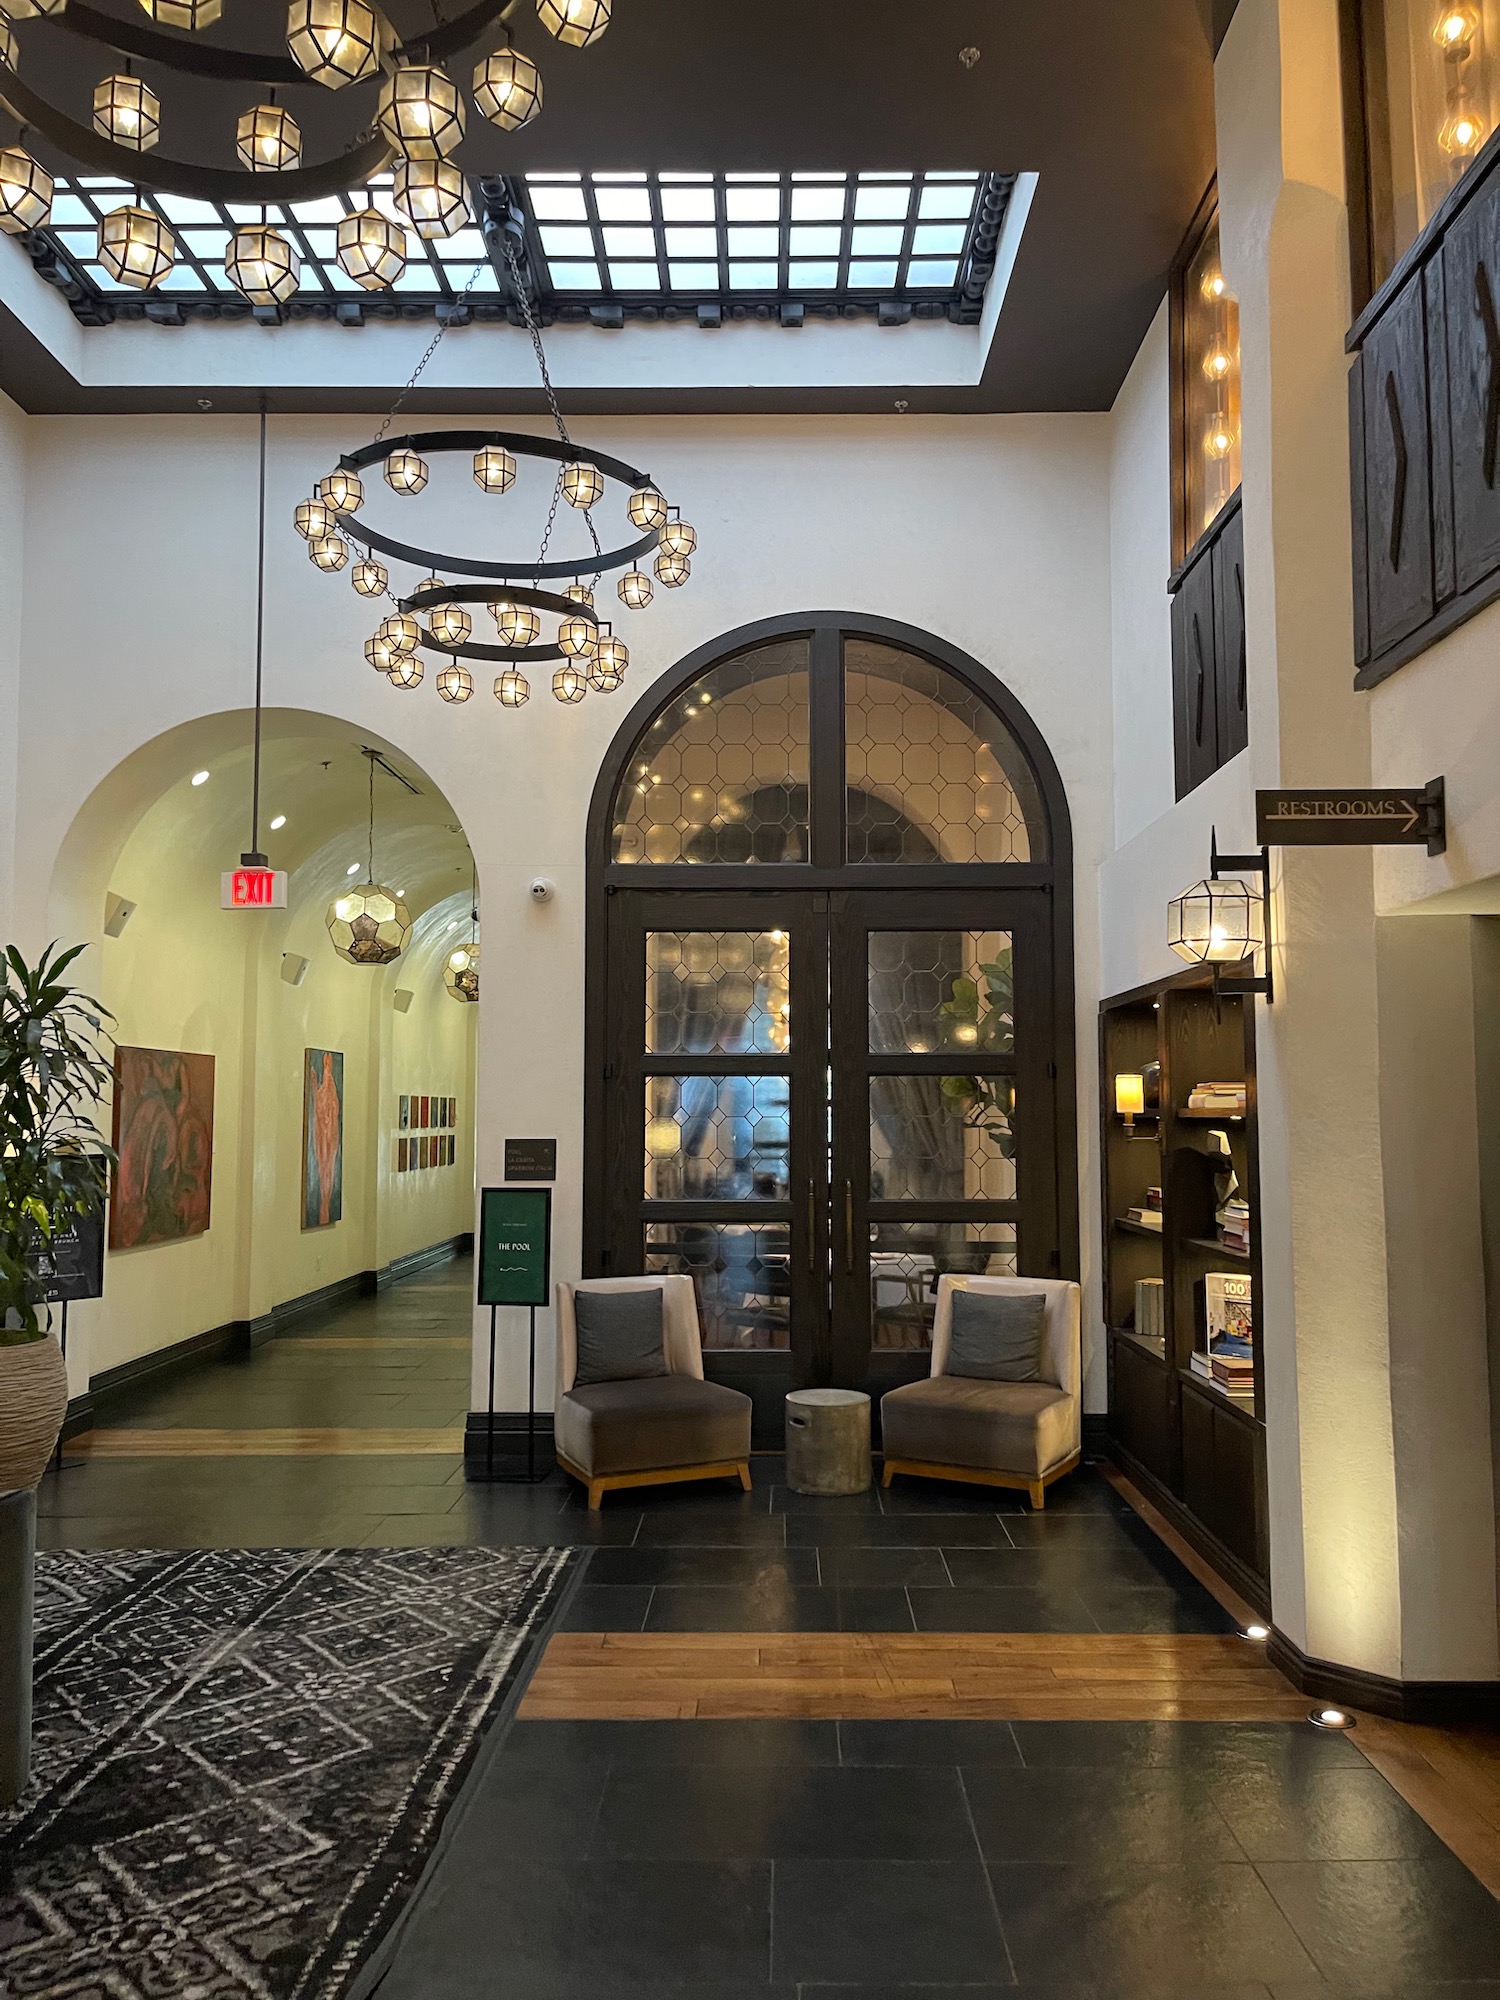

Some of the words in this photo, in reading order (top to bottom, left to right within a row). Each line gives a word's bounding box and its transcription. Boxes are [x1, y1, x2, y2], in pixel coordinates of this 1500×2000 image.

[1277, 801, 1396, 815] RESTROOMS
[232, 872, 276, 906] EXIT
[498, 1242, 511, 1251] THE
[512, 1242, 531, 1251] POOL
[1224, 1282, 1245, 1295] 100
